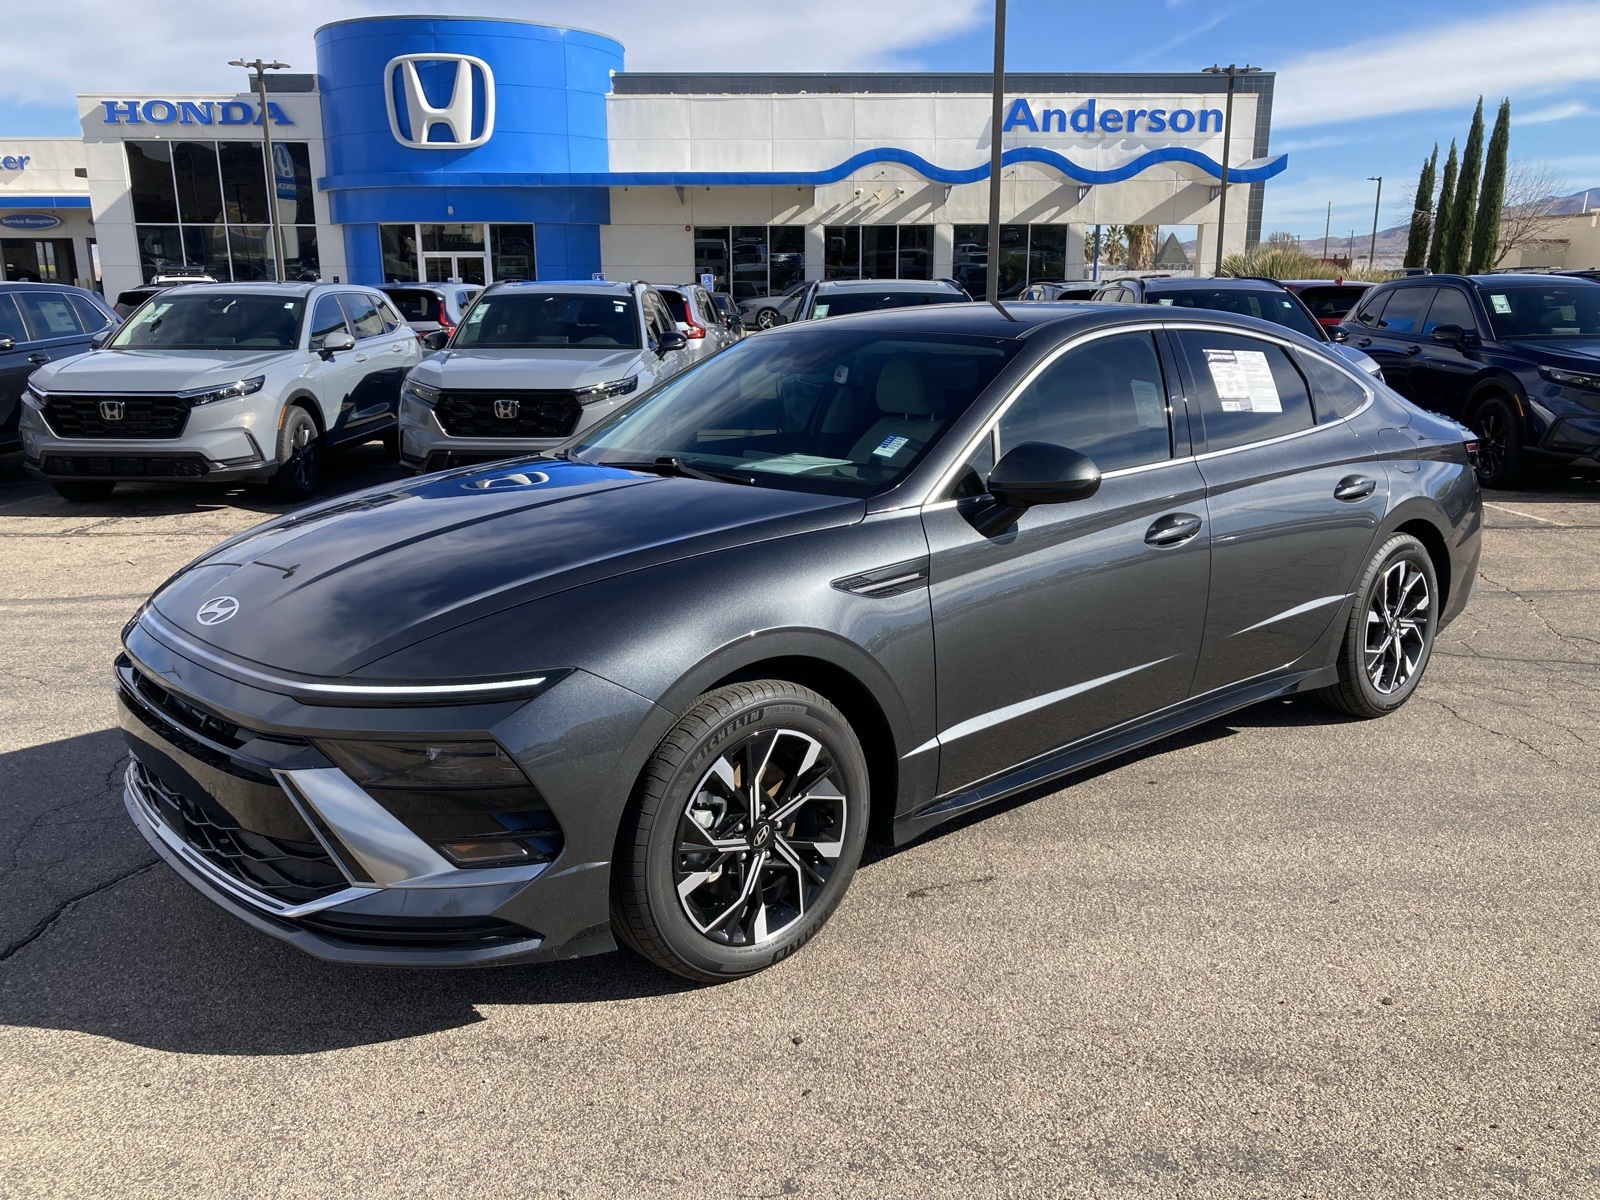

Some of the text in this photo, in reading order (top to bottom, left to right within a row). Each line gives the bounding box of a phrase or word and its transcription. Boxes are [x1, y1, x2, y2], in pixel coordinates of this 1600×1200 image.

[101, 100, 294, 126] HONDA
[1002, 98, 1223, 133] Anderson
[692, 709, 762, 769] MICHELIN
